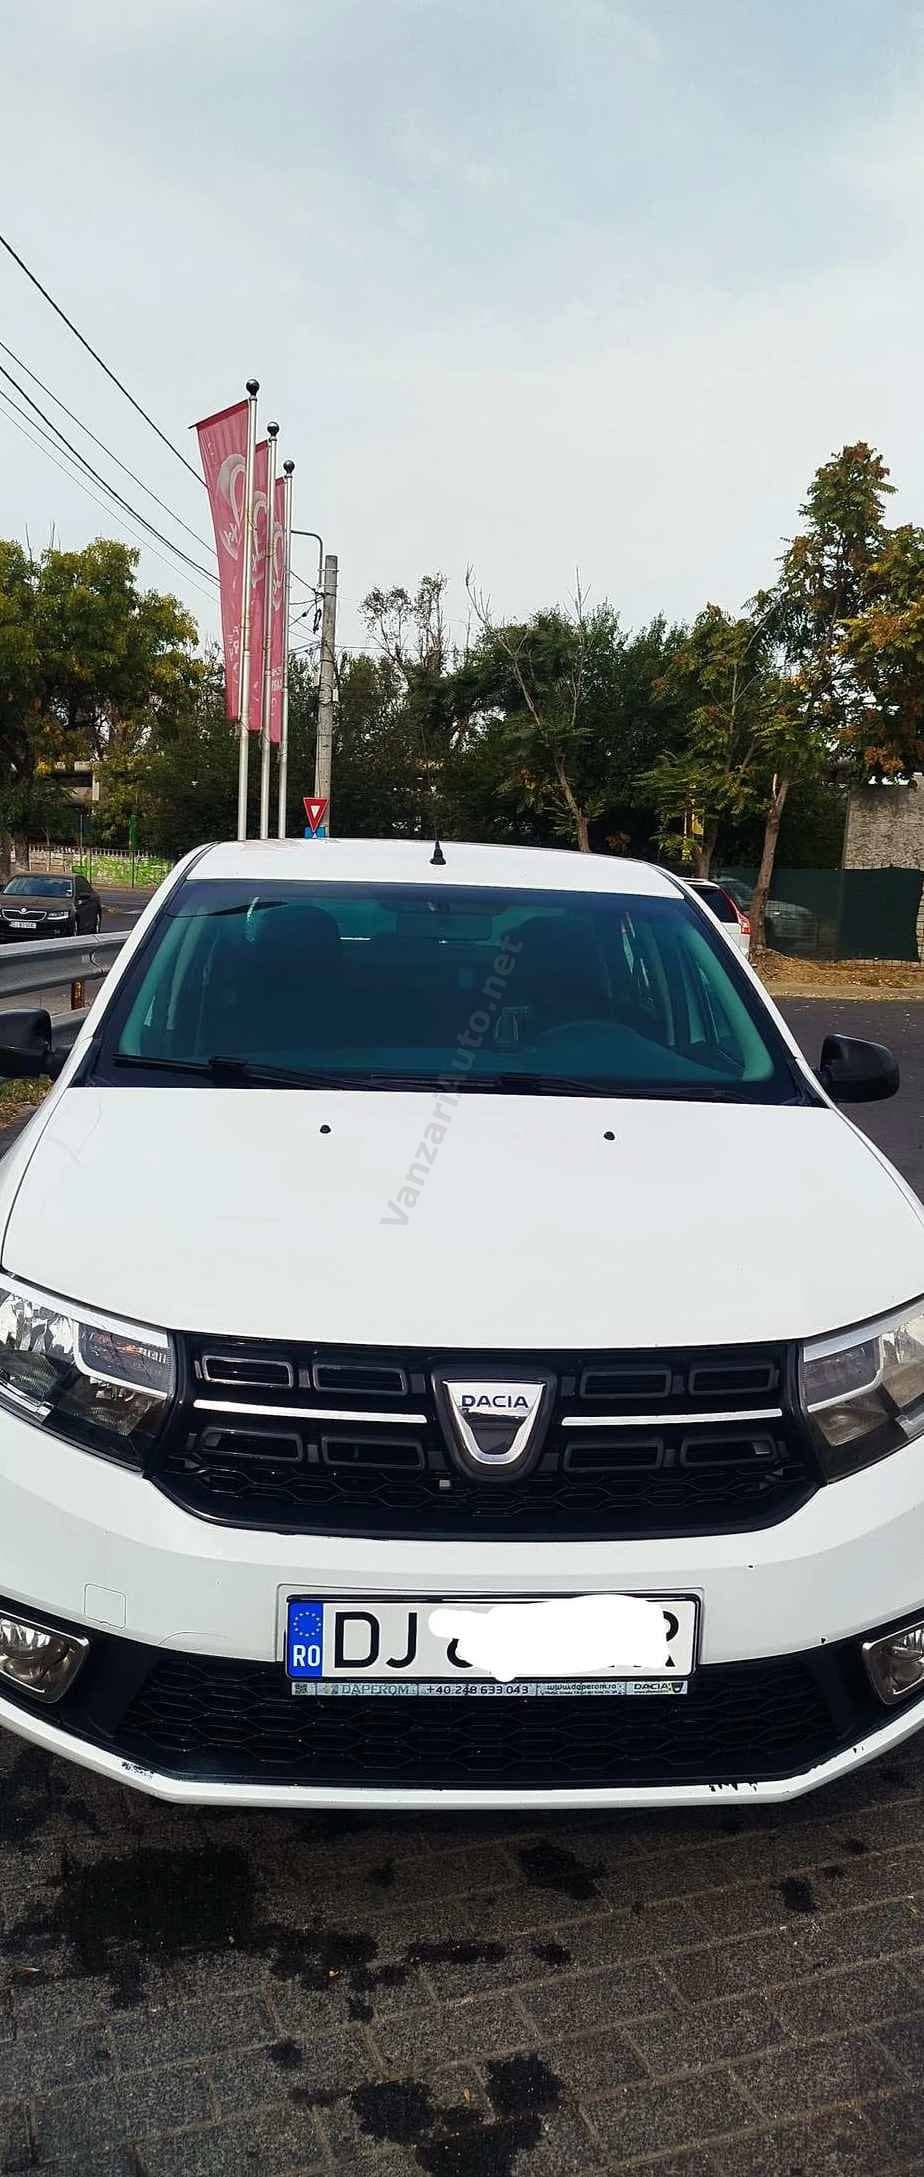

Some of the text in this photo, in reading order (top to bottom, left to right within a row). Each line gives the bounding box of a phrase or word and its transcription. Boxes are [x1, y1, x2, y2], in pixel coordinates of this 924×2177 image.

[461, 1395, 529, 1409] DACIA
[334, 1611, 418, 1668] DJ
[293, 1644, 321, 1667] RO
